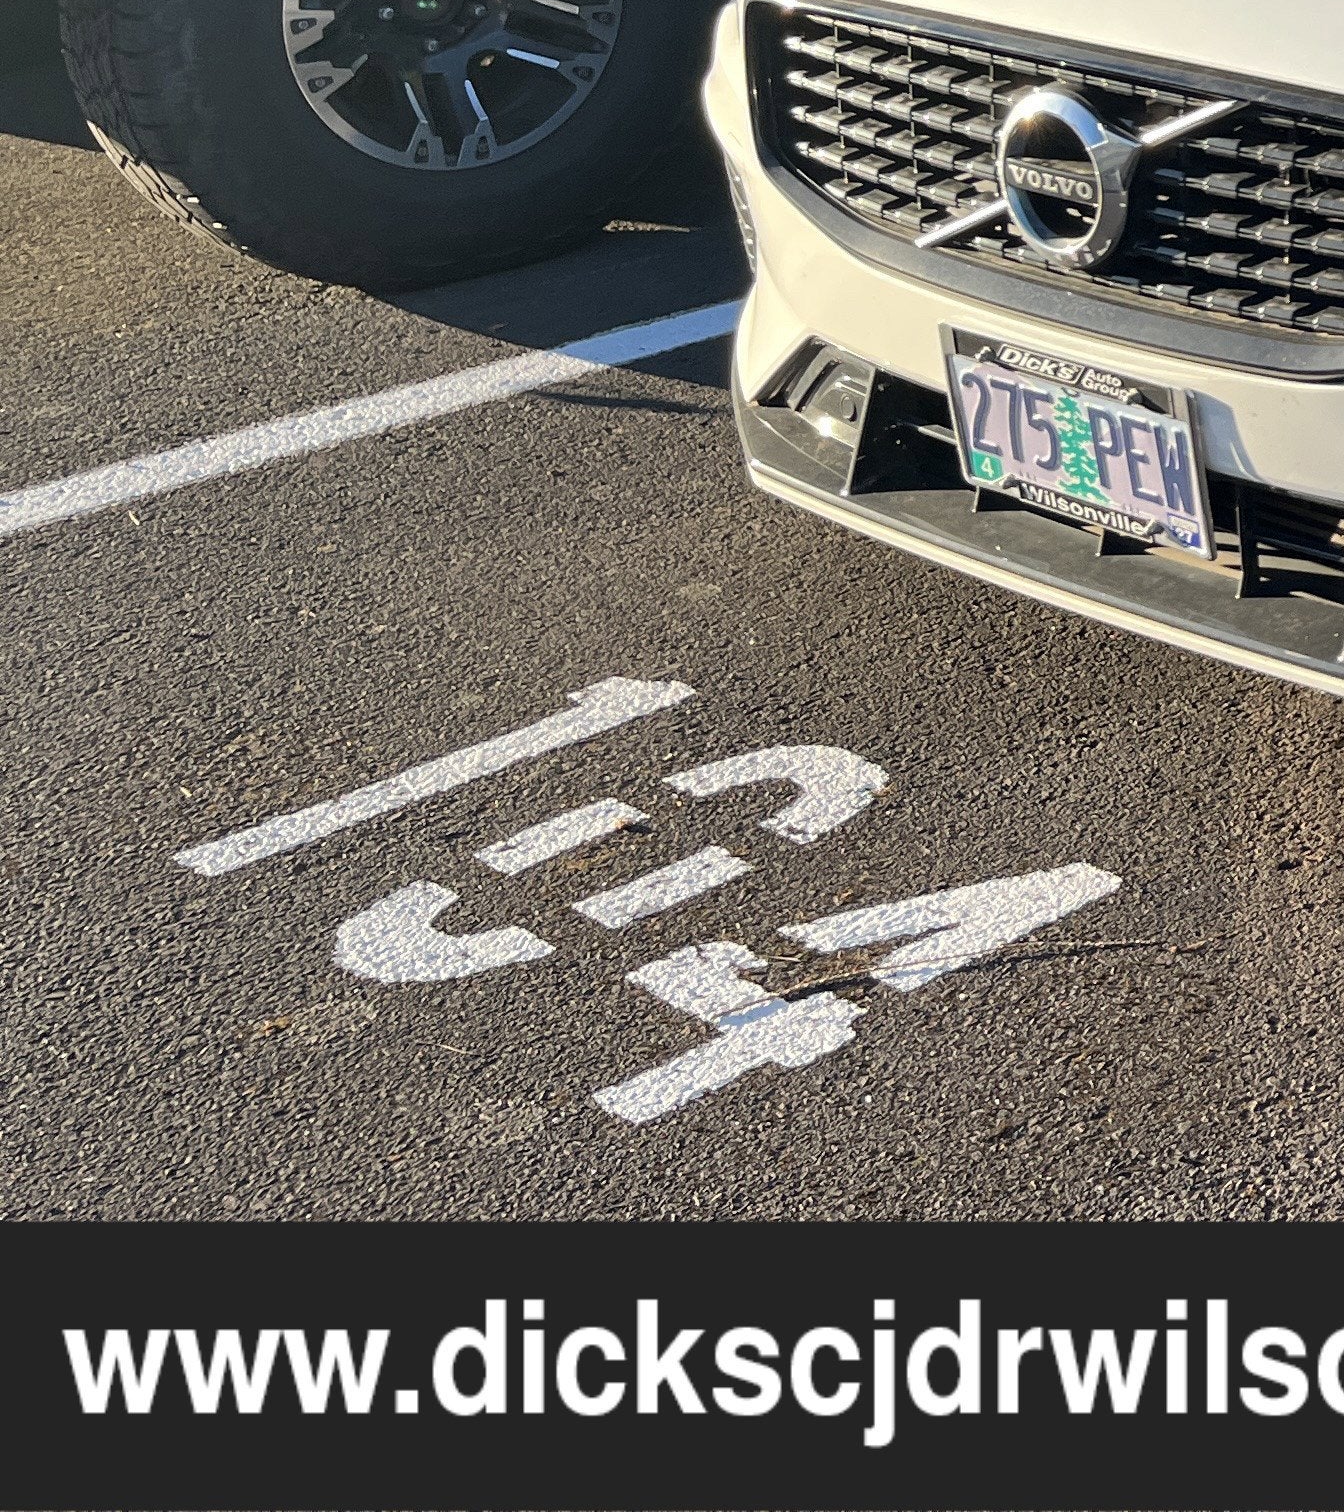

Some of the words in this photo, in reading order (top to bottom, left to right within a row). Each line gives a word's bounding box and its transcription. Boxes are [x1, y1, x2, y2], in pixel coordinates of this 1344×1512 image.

[1007, 164, 1093, 200] VOLVO
[1000, 348, 1076, 381] Dick's
[1084, 368, 1123, 388] Auto
[1081, 378, 1132, 403] Group
[961, 372, 1063, 472] 275
[1087, 406, 1196, 516] PEW
[981, 456, 996, 478] 4
[1021, 482, 1145, 536] Wilsonville
[172, 676, 1123, 1124] 104
